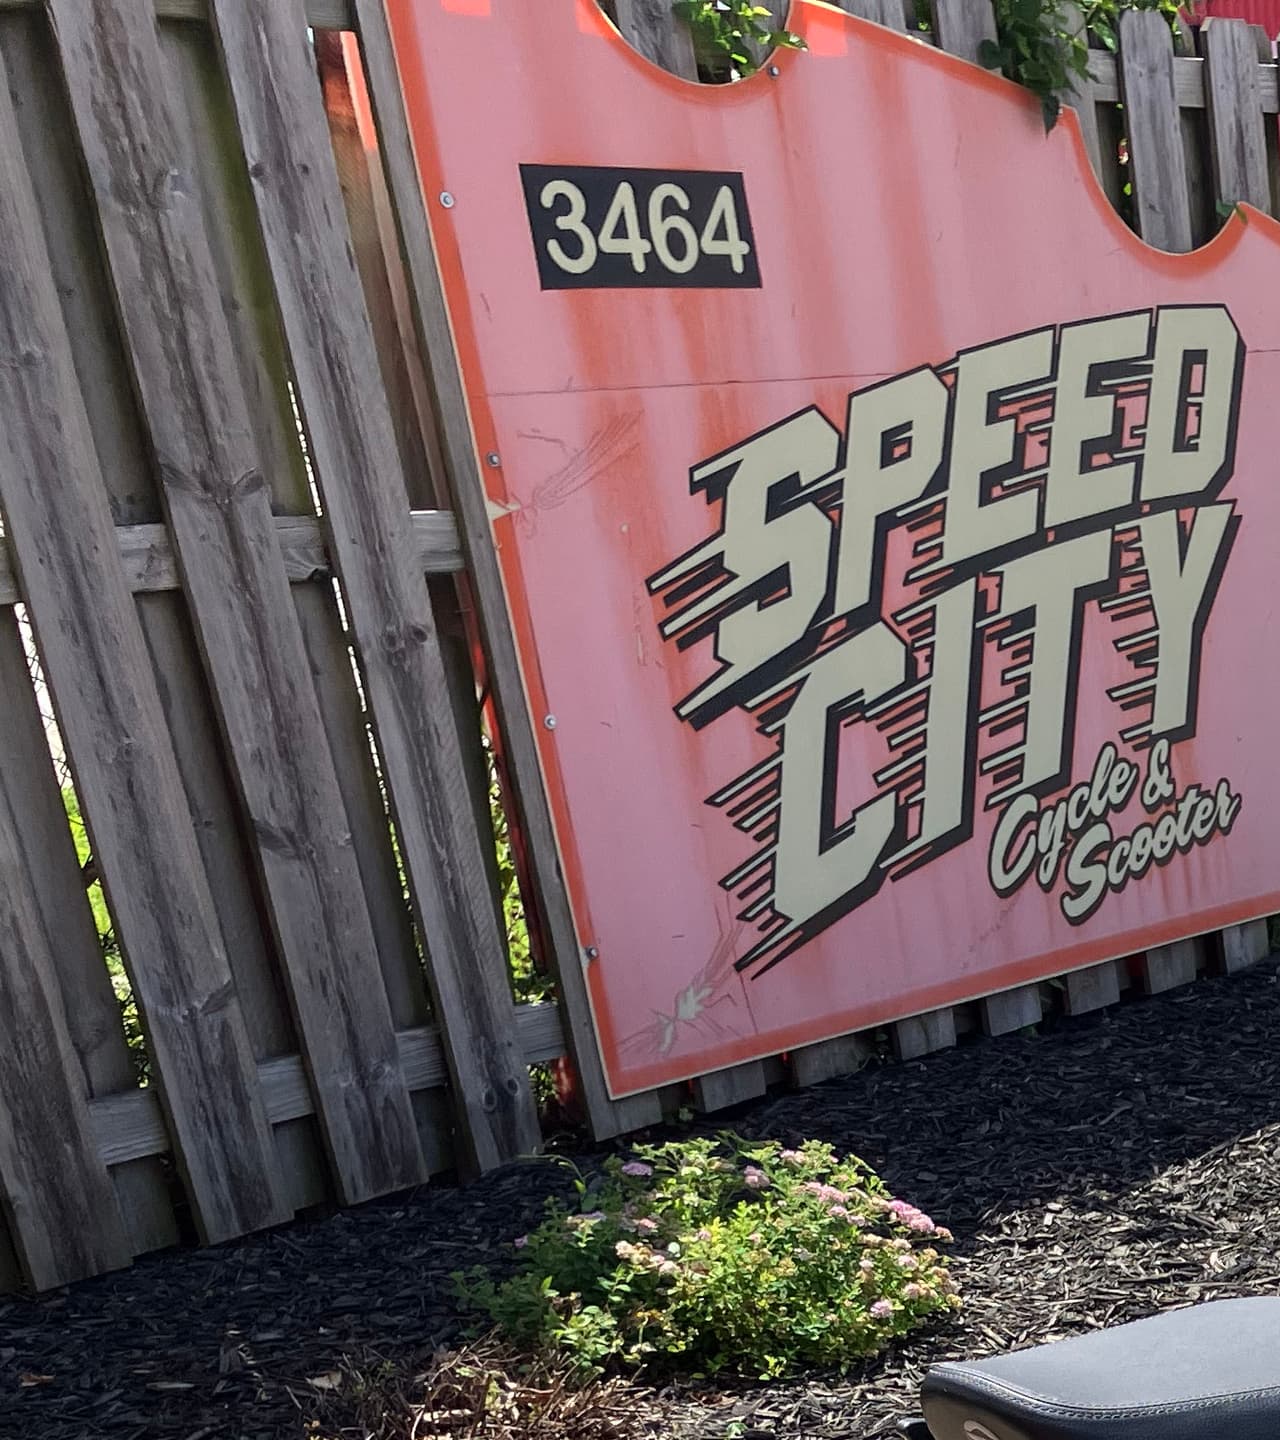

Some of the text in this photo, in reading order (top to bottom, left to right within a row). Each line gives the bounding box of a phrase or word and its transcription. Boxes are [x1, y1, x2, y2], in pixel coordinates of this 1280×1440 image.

[540, 179, 750, 274] 3464
[646, 304, 1247, 731] SPEED
[703, 499, 1241, 978] CITY
[988, 737, 1175, 899] Cycle &
[1060, 778, 1242, 926] Scooter
